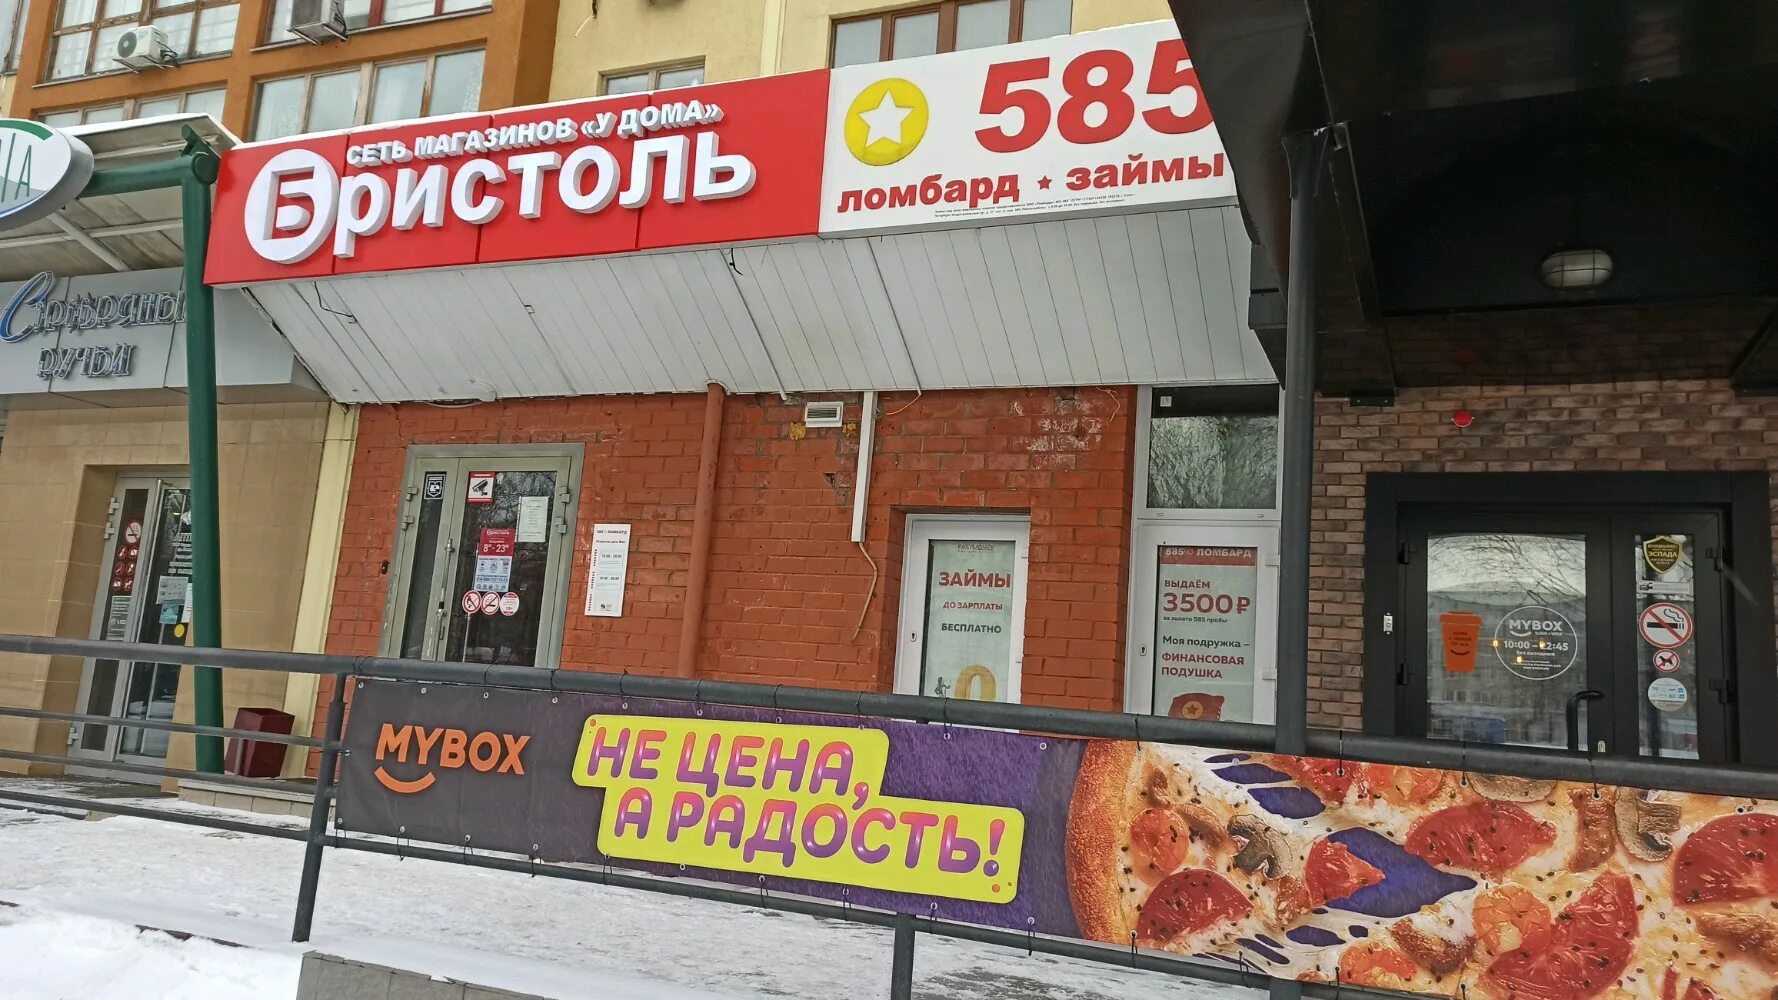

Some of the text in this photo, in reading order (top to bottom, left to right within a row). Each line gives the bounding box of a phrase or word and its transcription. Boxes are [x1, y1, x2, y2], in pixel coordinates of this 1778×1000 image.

[974, 38, 1214, 154] 585
[346, 140, 413, 168] СЕТЬ
[414, 118, 579, 160] МАГАЗИНОВ
[617, 99, 725, 140] ДОМА»
[836, 172, 1020, 214] ломбард
[1065, 152, 1224, 191] займы
[1165, 547, 1252, 559] 585 ЛОМБАРД
[938, 568, 1011, 588] ЗАЙМЫ
[1164, 579, 1211, 590] ВЫДАЁМ
[943, 602, 1003, 611] ДО ЗАРПЛАТЫ
[941, 623, 1002, 634] БЕСПЛАТНО
[1508, 620, 1563, 632] MYBOX
[1162, 635, 1185, 646] Моя
[1186, 638, 1241, 649] подружка
[1503, 640, 1530, 649] 10:00
[1161, 652, 1244, 666] ФИНАНСОВАЯ
[1161, 666, 1223, 679] ПОДУШКА
[374, 722, 532, 777] MYBOX
[587, 726, 869, 811] НЕ ЦЕНА,
[613, 786, 1006, 878] А РАДОСТЬ!
